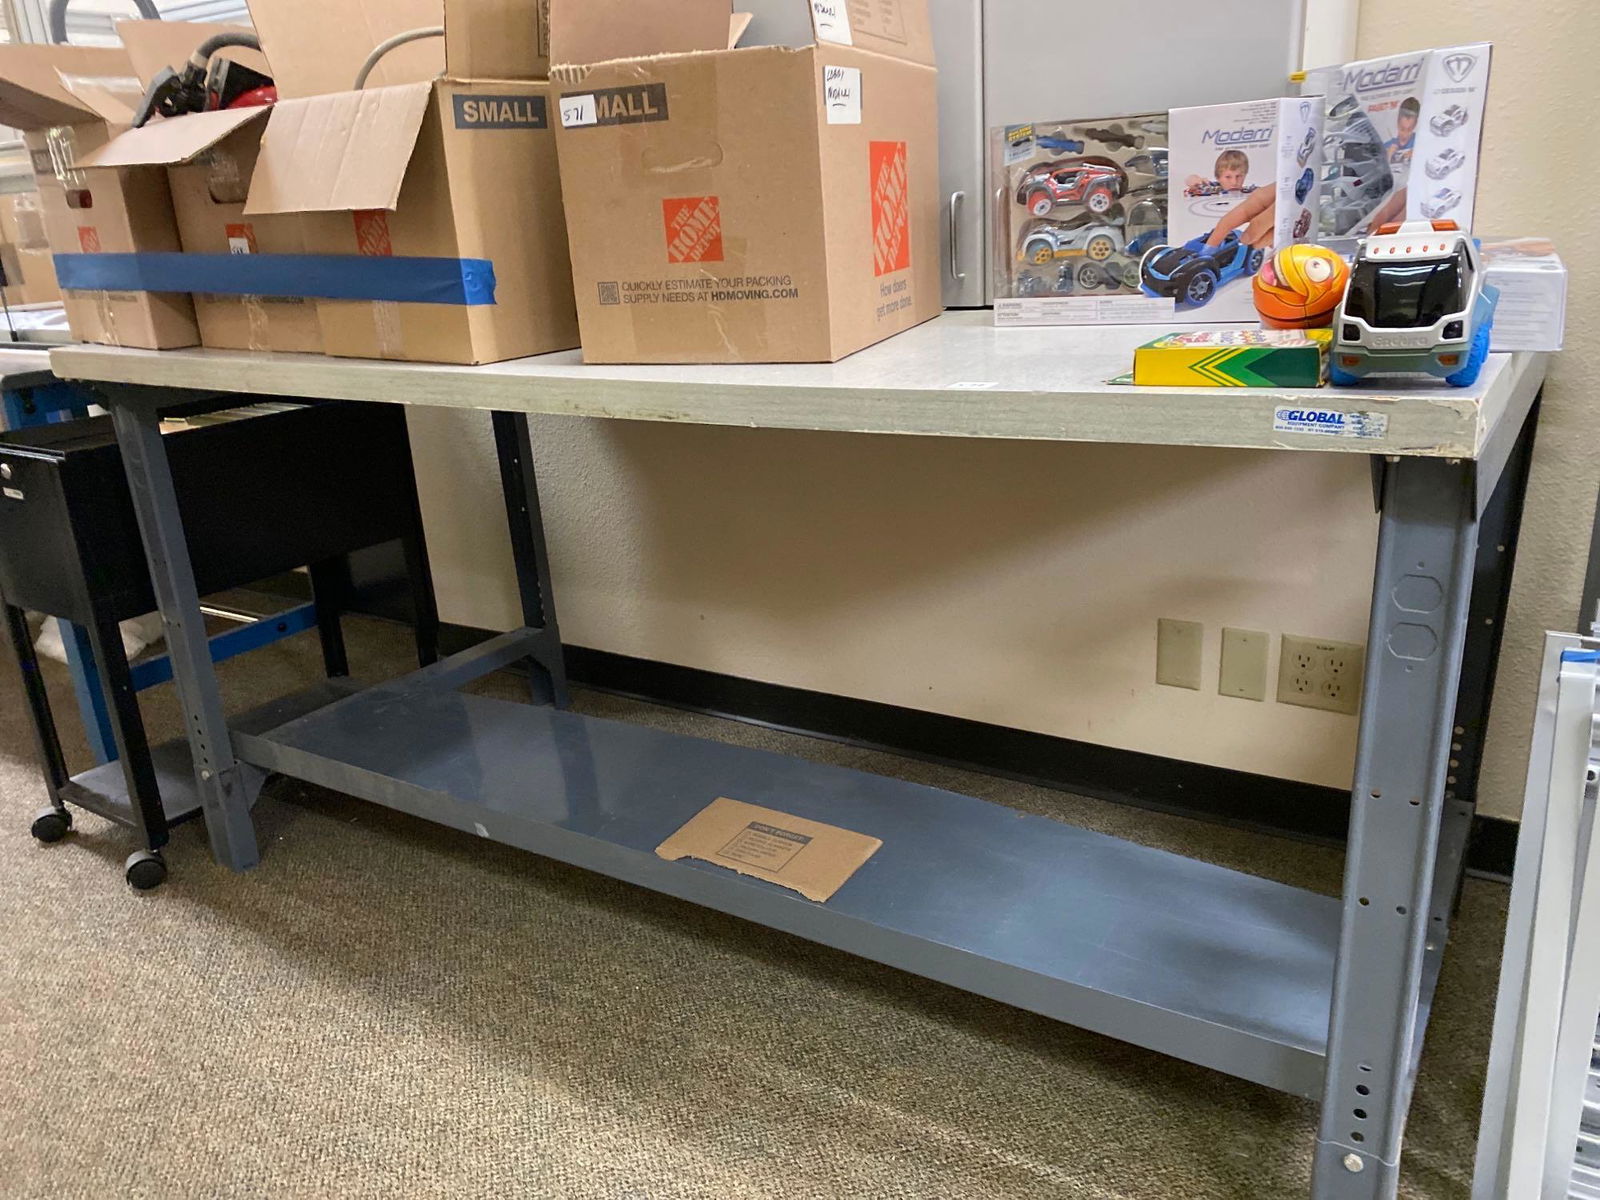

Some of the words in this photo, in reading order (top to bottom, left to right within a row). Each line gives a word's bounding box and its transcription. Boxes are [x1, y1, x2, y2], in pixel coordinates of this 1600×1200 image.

[1343, 58, 1424, 91] Modarri
[463, 101, 539, 122] SMALL
[597, 90, 658, 119] MALL
[1202, 127, 1275, 144] Modarri
[671, 205, 692, 230] THE
[875, 143, 906, 273] HOME
[669, 198, 720, 261] HOME
[690, 222, 721, 261] DEPOT
[622, 281, 662, 291] QUICKLY
[665, 279, 712, 290] ESTIMATE
[715, 277, 744, 289] YOUR
[746, 275, 791, 287] PACKING
[623, 292, 660, 304] SUPPLY
[662, 292, 694, 303] NEEDS
[697, 292, 709, 302] AT
[711, 288, 799, 302] HDMOVING.COM
[1288, 410, 1345, 424] GLOBAL
